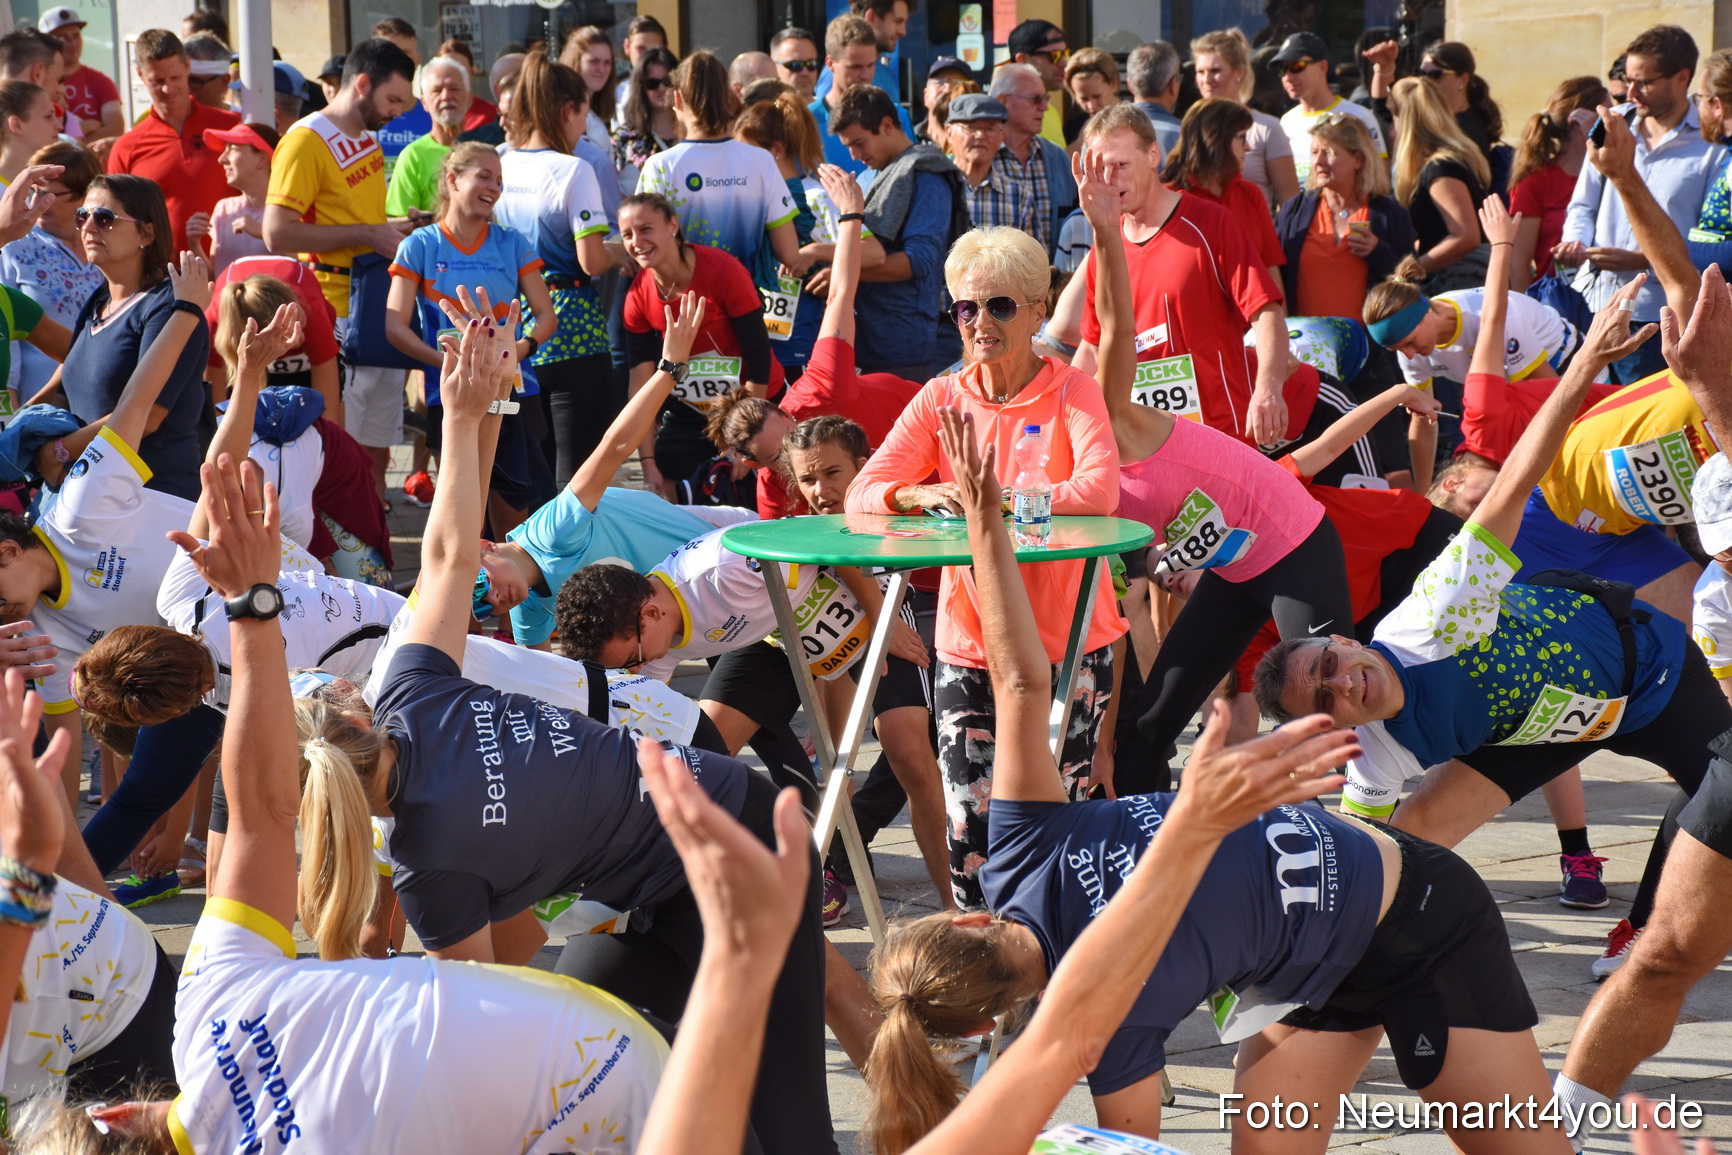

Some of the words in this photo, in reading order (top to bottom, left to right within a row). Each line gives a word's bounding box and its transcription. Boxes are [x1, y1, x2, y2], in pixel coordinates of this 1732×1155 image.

[345, 164, 371, 188] MAX
[705, 176, 747, 187] Bionorica
[764, 295, 788, 316] 08
[273, 359, 304, 373] 87
[686, 358, 734, 375] OCK
[1135, 359, 1187, 386] OCK
[1136, 385, 1188, 412] 189
[1684, 424, 1710, 464] MA
[1616, 467, 1650, 517] ROBERT
[1632, 451, 1686, 518] 2390
[1165, 498, 1208, 542] OCK
[102, 546, 117, 590] Neumarkter
[112, 556, 127, 592] Stadtlauf
[707, 628, 725, 642] 20
[800, 601, 855, 659] 013
[821, 636, 861, 671] DAVID
[505, 709, 535, 745] mit
[1547, 709, 1598, 741] 12
[471, 700, 508, 828] Beratung
[1067, 848, 1109, 918] tung
[1265, 822, 1320, 915] m
[238, 1012, 301, 1146] Stadtlauf
[577, 1050, 621, 1102] September
[615, 1034, 631, 1055] 2019
